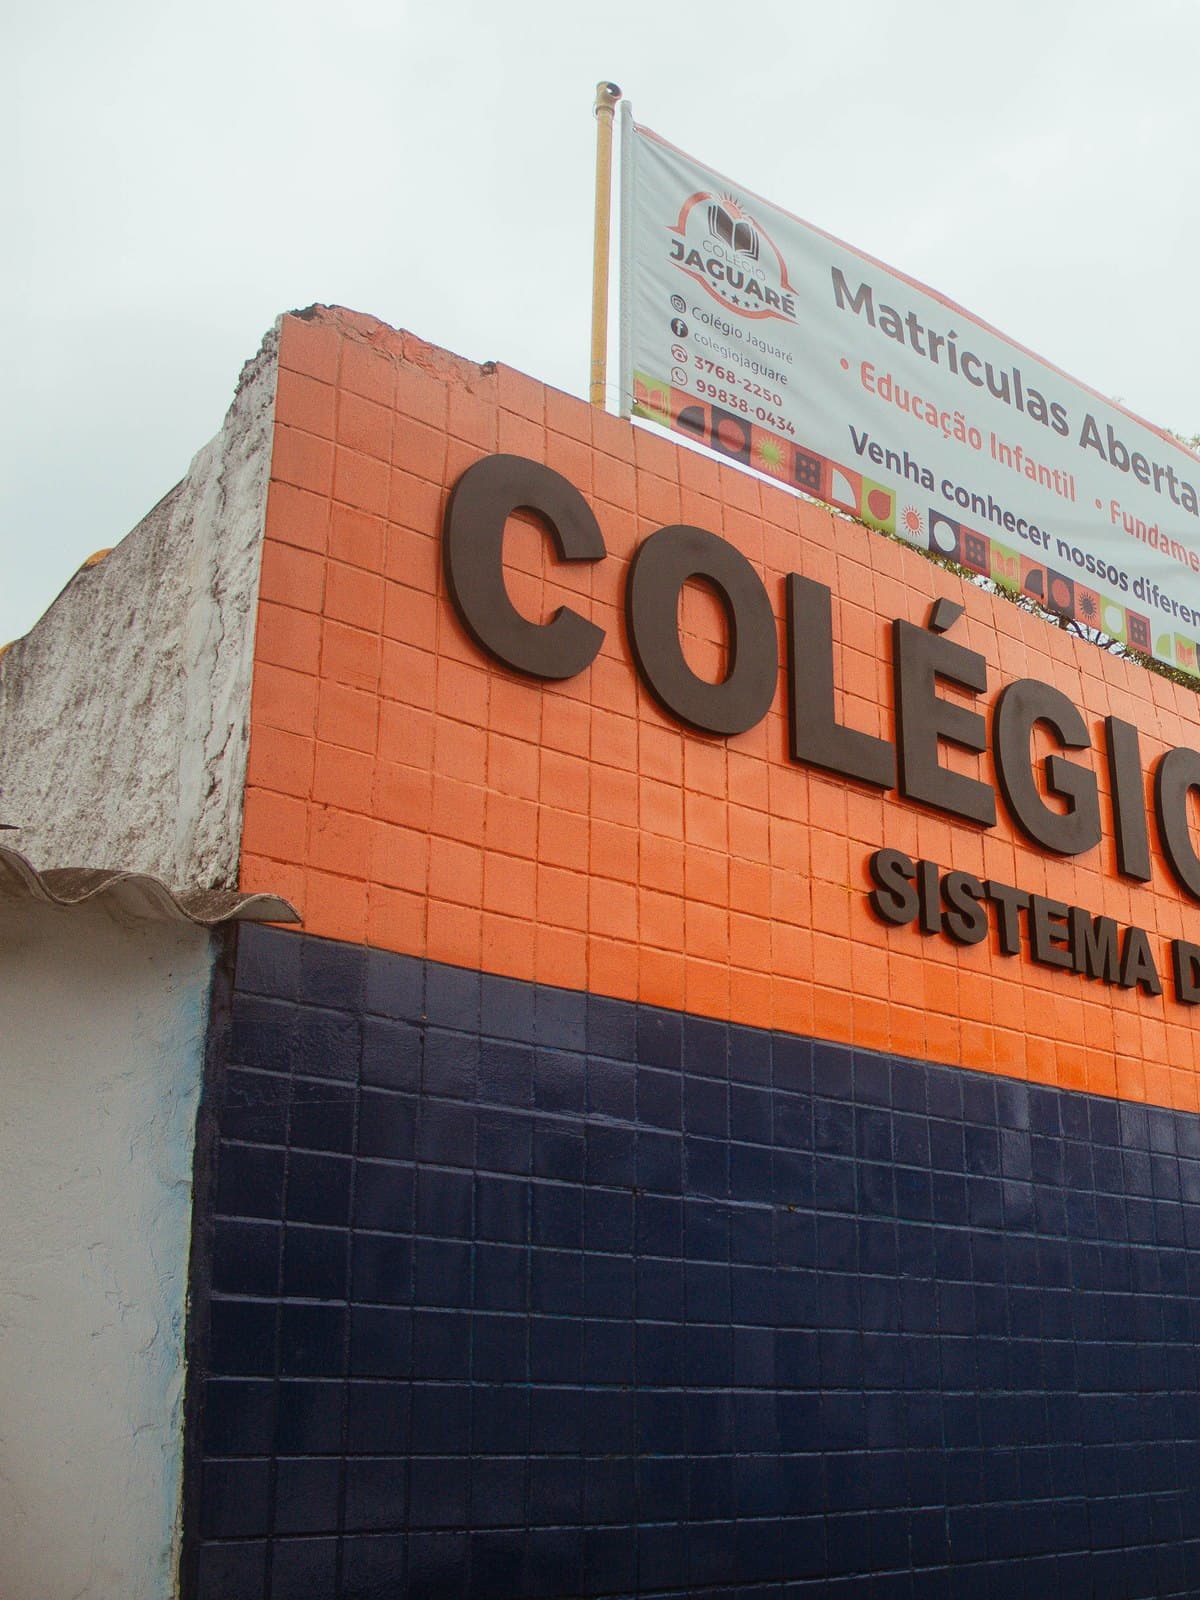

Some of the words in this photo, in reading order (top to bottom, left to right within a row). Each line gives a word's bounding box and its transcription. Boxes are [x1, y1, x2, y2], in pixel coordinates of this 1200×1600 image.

[670, 239, 797, 318] JAGUARÉ
[692, 306, 743, 339] Colégio
[746, 333, 793, 364] Jaguaré
[694, 333, 788, 385] colegiojaguare
[831, 266, 1069, 437] Matrículas
[694, 356, 782, 407] 3768-2250
[696, 379, 796, 435] 99838-0434
[860, 361, 982, 450] Educação
[990, 432, 1076, 502] Infantil
[848, 424, 935, 492] Venha
[941, 479, 1050, 550] conhecer
[1056, 538, 1129, 592] nossos
[869, 848, 1162, 996] SISTEMA
